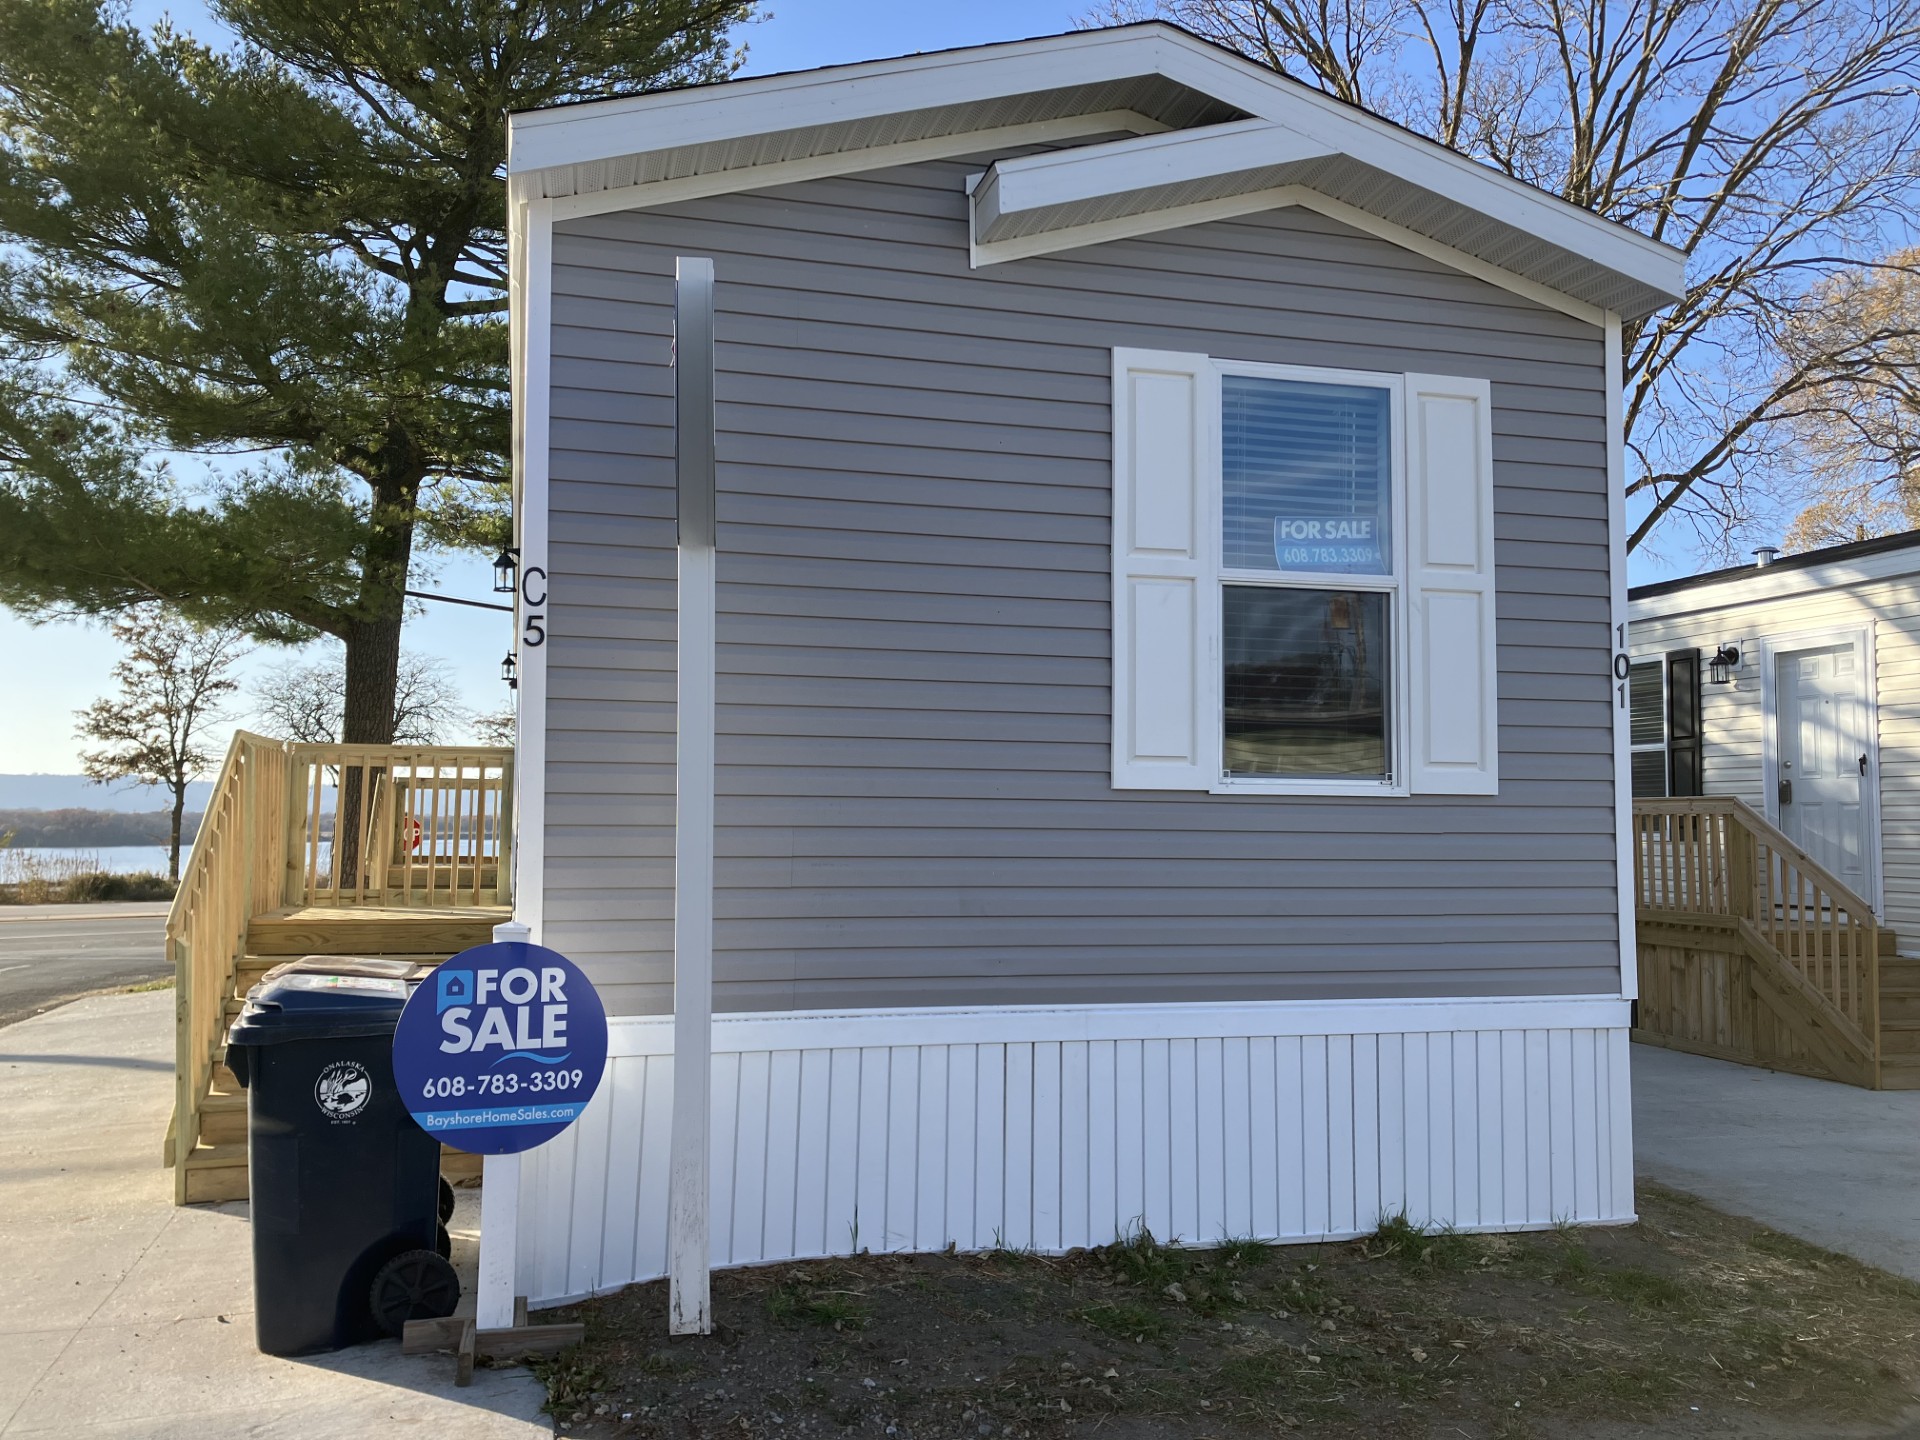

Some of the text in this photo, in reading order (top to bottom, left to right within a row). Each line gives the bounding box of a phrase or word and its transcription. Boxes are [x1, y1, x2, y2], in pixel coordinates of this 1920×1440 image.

[1281, 520, 1371, 539] FOR SALE
[1283, 547, 1373, 564] 608.783.3309
[1614, 622, 1630, 708] 101
[476, 967, 568, 1005] FOR
[439, 1004, 568, 1054] SALE
[323, 1060, 365, 1073] ONALASKA
[422, 1069, 583, 1098] 608-783-3309
[321, 1106, 363, 1119] WISCONSIN
[426, 1107, 574, 1129] BayshoreHomeSales.com
